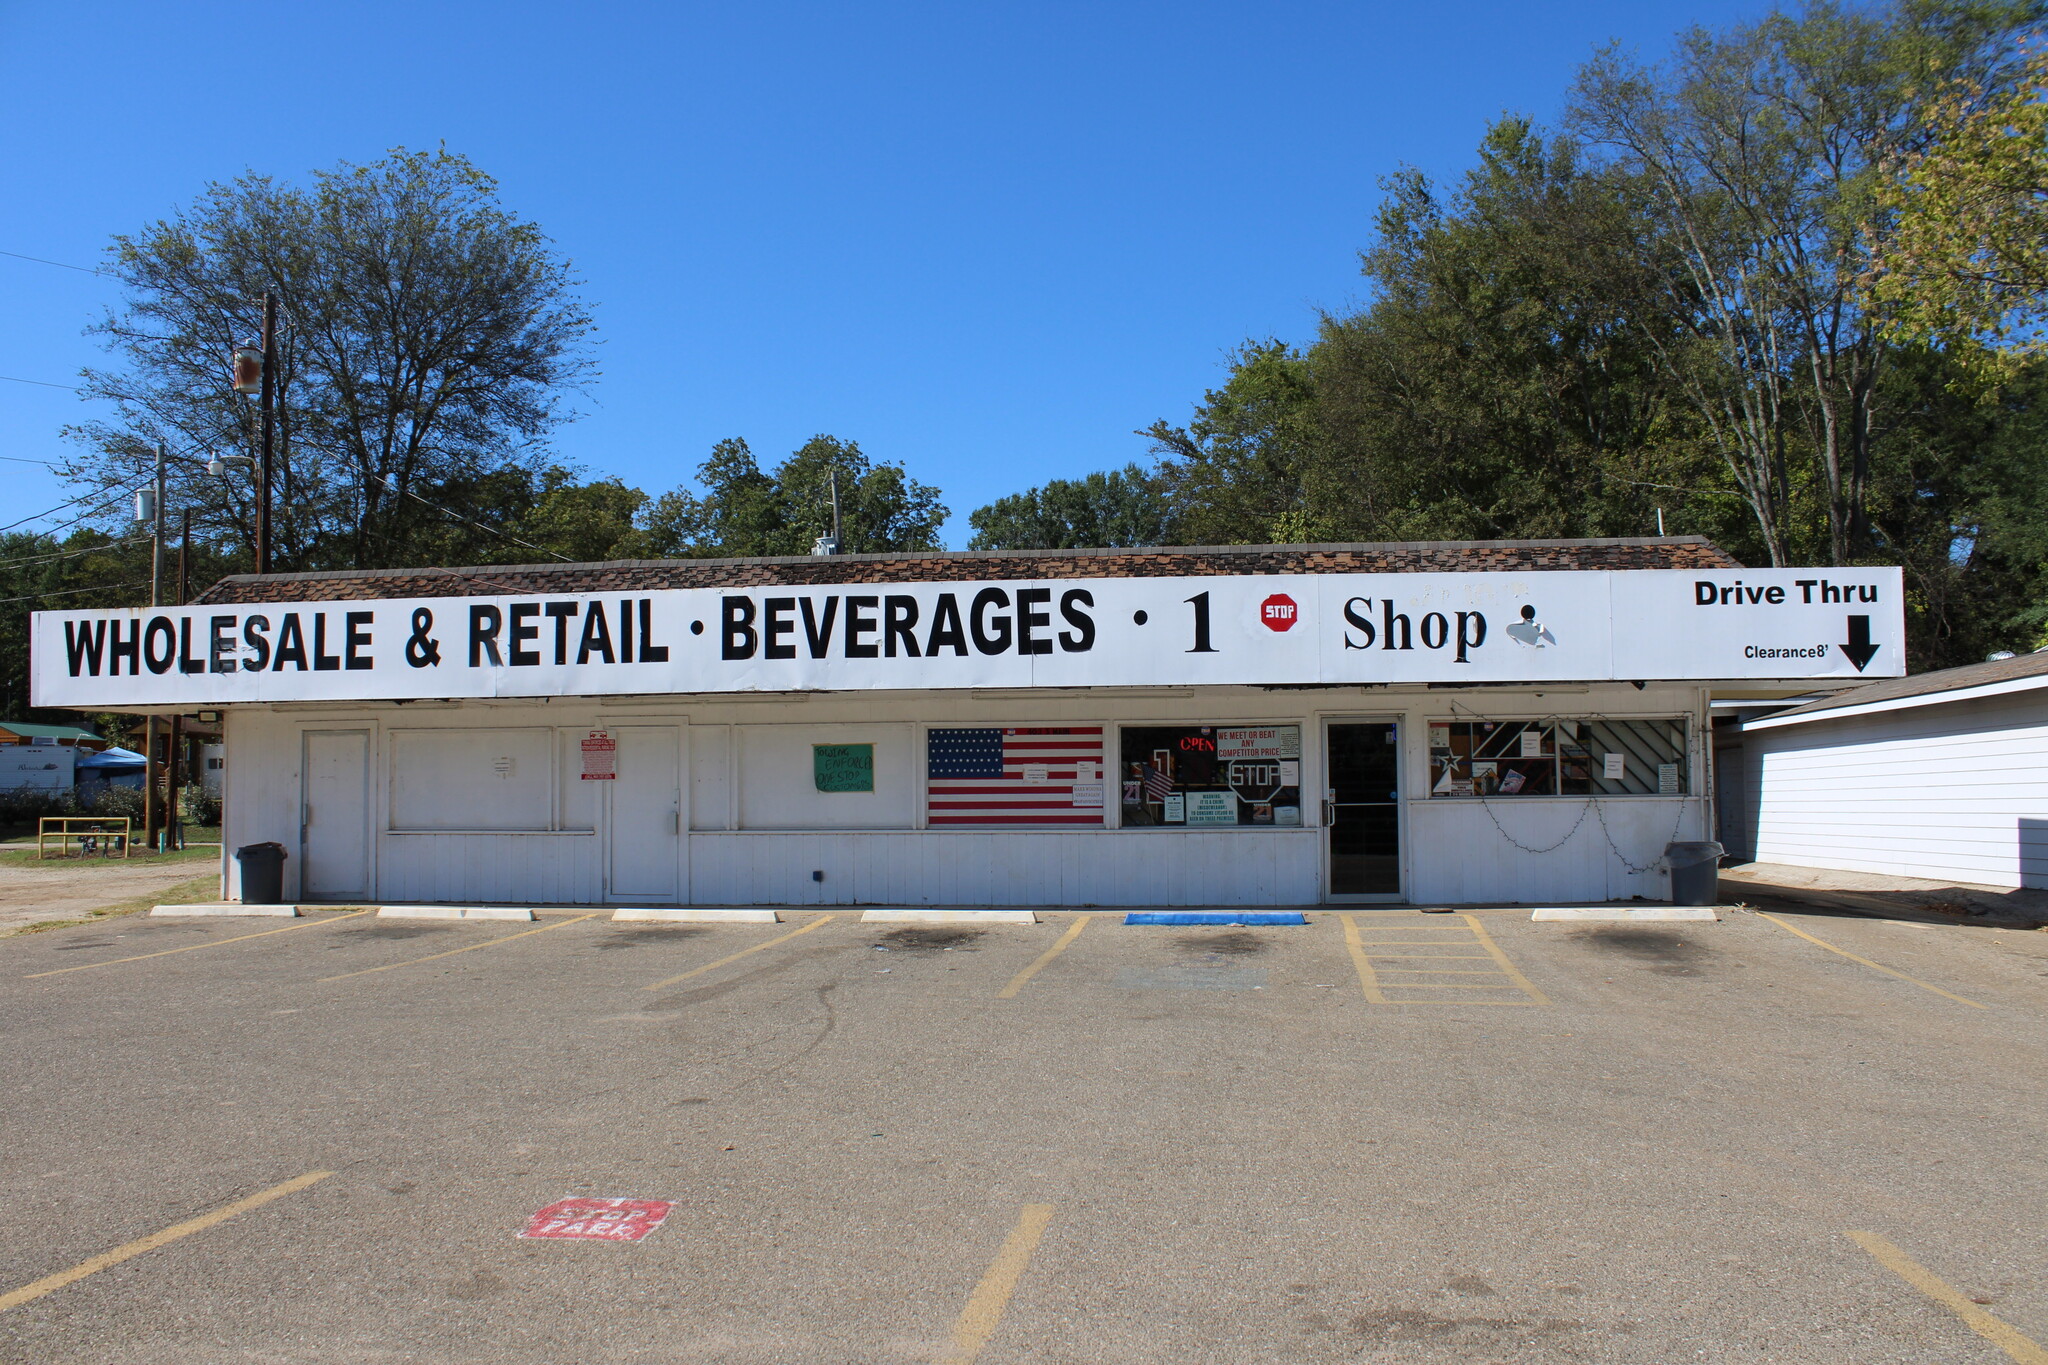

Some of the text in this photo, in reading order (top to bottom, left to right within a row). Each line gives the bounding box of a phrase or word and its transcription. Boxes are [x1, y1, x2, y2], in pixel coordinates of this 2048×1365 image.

[1695, 579, 1878, 606] Drive Thru
[64, 587, 1487, 678] WHOLESALE & RETAIL BEVERAGES 1 STOP Shop
[1218, 730, 1276, 740] WE MEET OR BEAT
[1180, 736, 1215, 752] OPEN
[815, 748, 849, 757] TOWING
[1218, 747, 1280, 757] COMPETITOR PRICE
[1231, 764, 1281, 786] STOP
[1123, 785, 1141, 800] 21
[1253, 806, 1272, 817] 21
[540, 1220, 636, 1237] PARK
